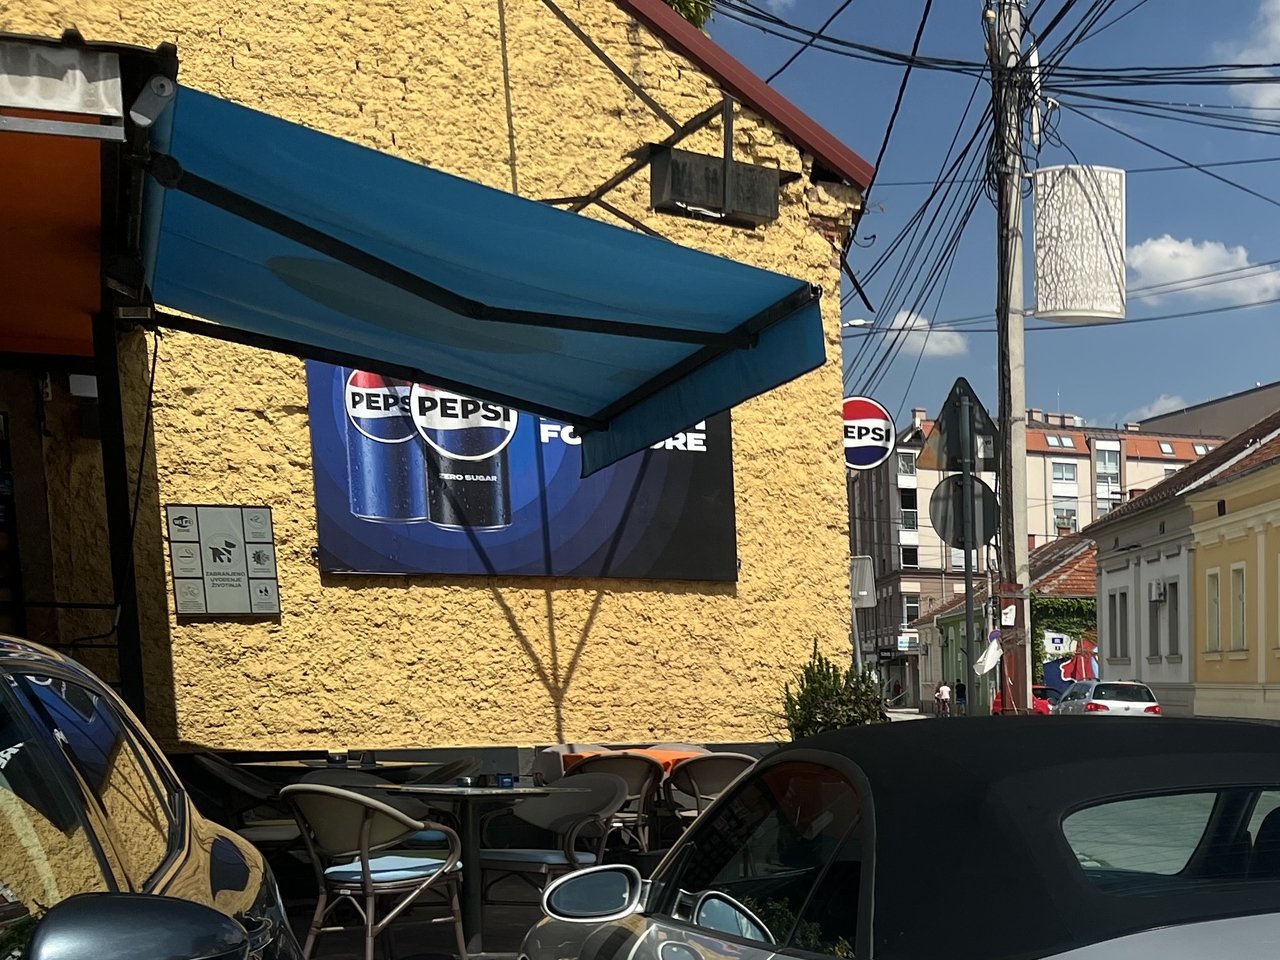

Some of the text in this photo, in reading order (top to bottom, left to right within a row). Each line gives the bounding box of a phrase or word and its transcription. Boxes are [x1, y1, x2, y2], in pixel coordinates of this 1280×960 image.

[351, 392, 411, 413] PEPS
[418, 396, 511, 422] PEPSI
[844, 425, 891, 442] EPSI
[439, 472, 464, 480] ZERO
